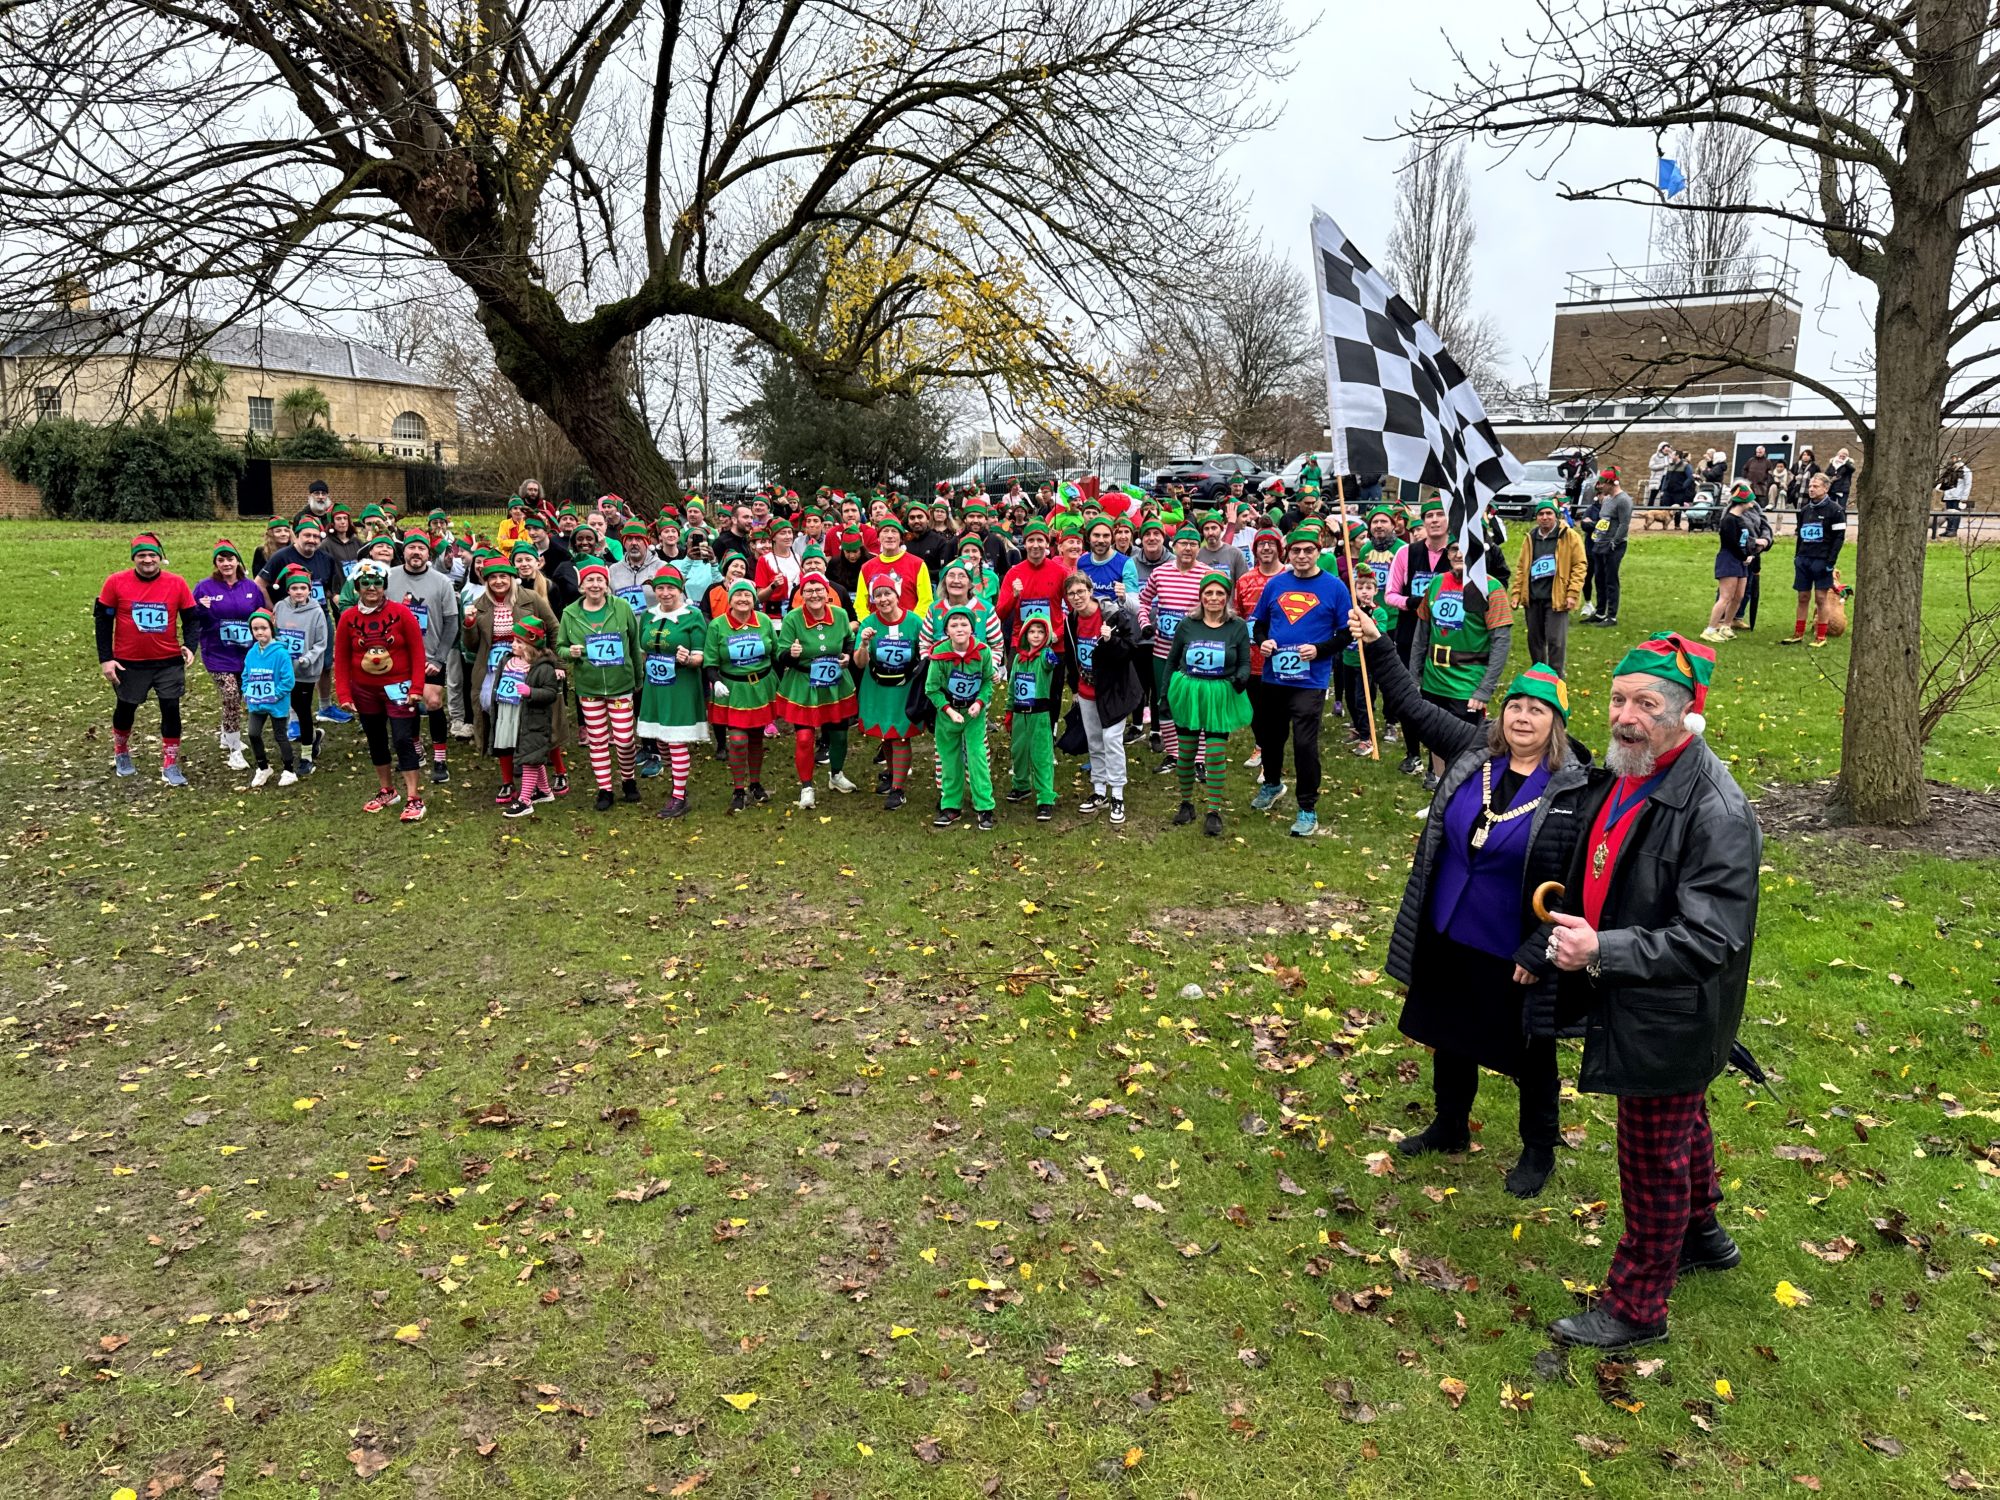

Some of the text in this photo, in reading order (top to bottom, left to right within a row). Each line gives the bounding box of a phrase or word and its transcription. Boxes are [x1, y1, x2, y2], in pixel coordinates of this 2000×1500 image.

[1803, 528, 1820, 537] 144
[1535, 561, 1549, 572] 49
[135, 610, 166, 624] 114
[1439, 602, 1458, 618] 80
[1158, 618, 1182, 633] 137
[223, 628, 248, 639] 117
[594, 643, 617, 658] 74
[736, 642, 756, 658] 77
[884, 649, 904, 662] 75
[1194, 650, 1214, 666] 21
[1279, 655, 1302, 671] 22
[650, 662, 667, 677] 39
[818, 665, 837, 679] 76
[250, 682, 272, 696] 116
[499, 680, 516, 694] 78
[955, 681, 976, 694] 87
